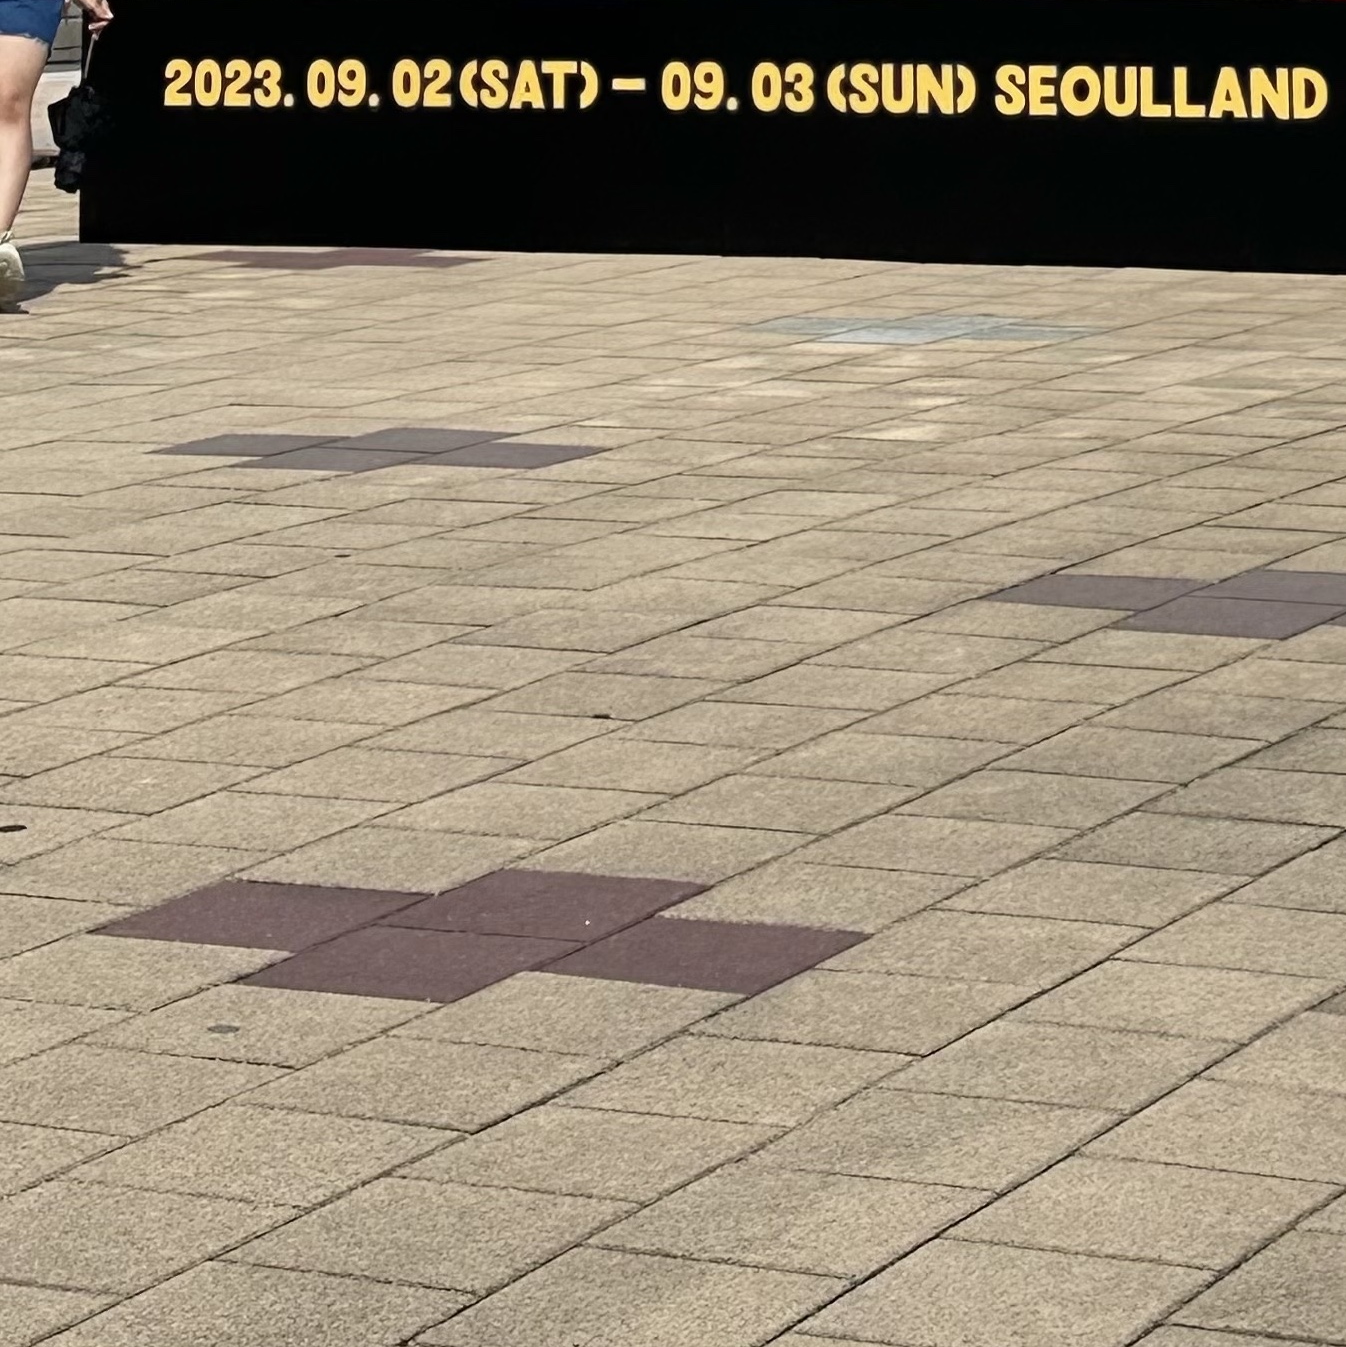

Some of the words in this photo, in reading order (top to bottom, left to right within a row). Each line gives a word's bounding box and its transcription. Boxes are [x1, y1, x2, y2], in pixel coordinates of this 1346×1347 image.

[163, 58, 295, 108] 2023.
[306, 58, 380, 108] 09.
[661, 61, 738, 111] 09.
[994, 64, 1328, 121] SEOULLAND
